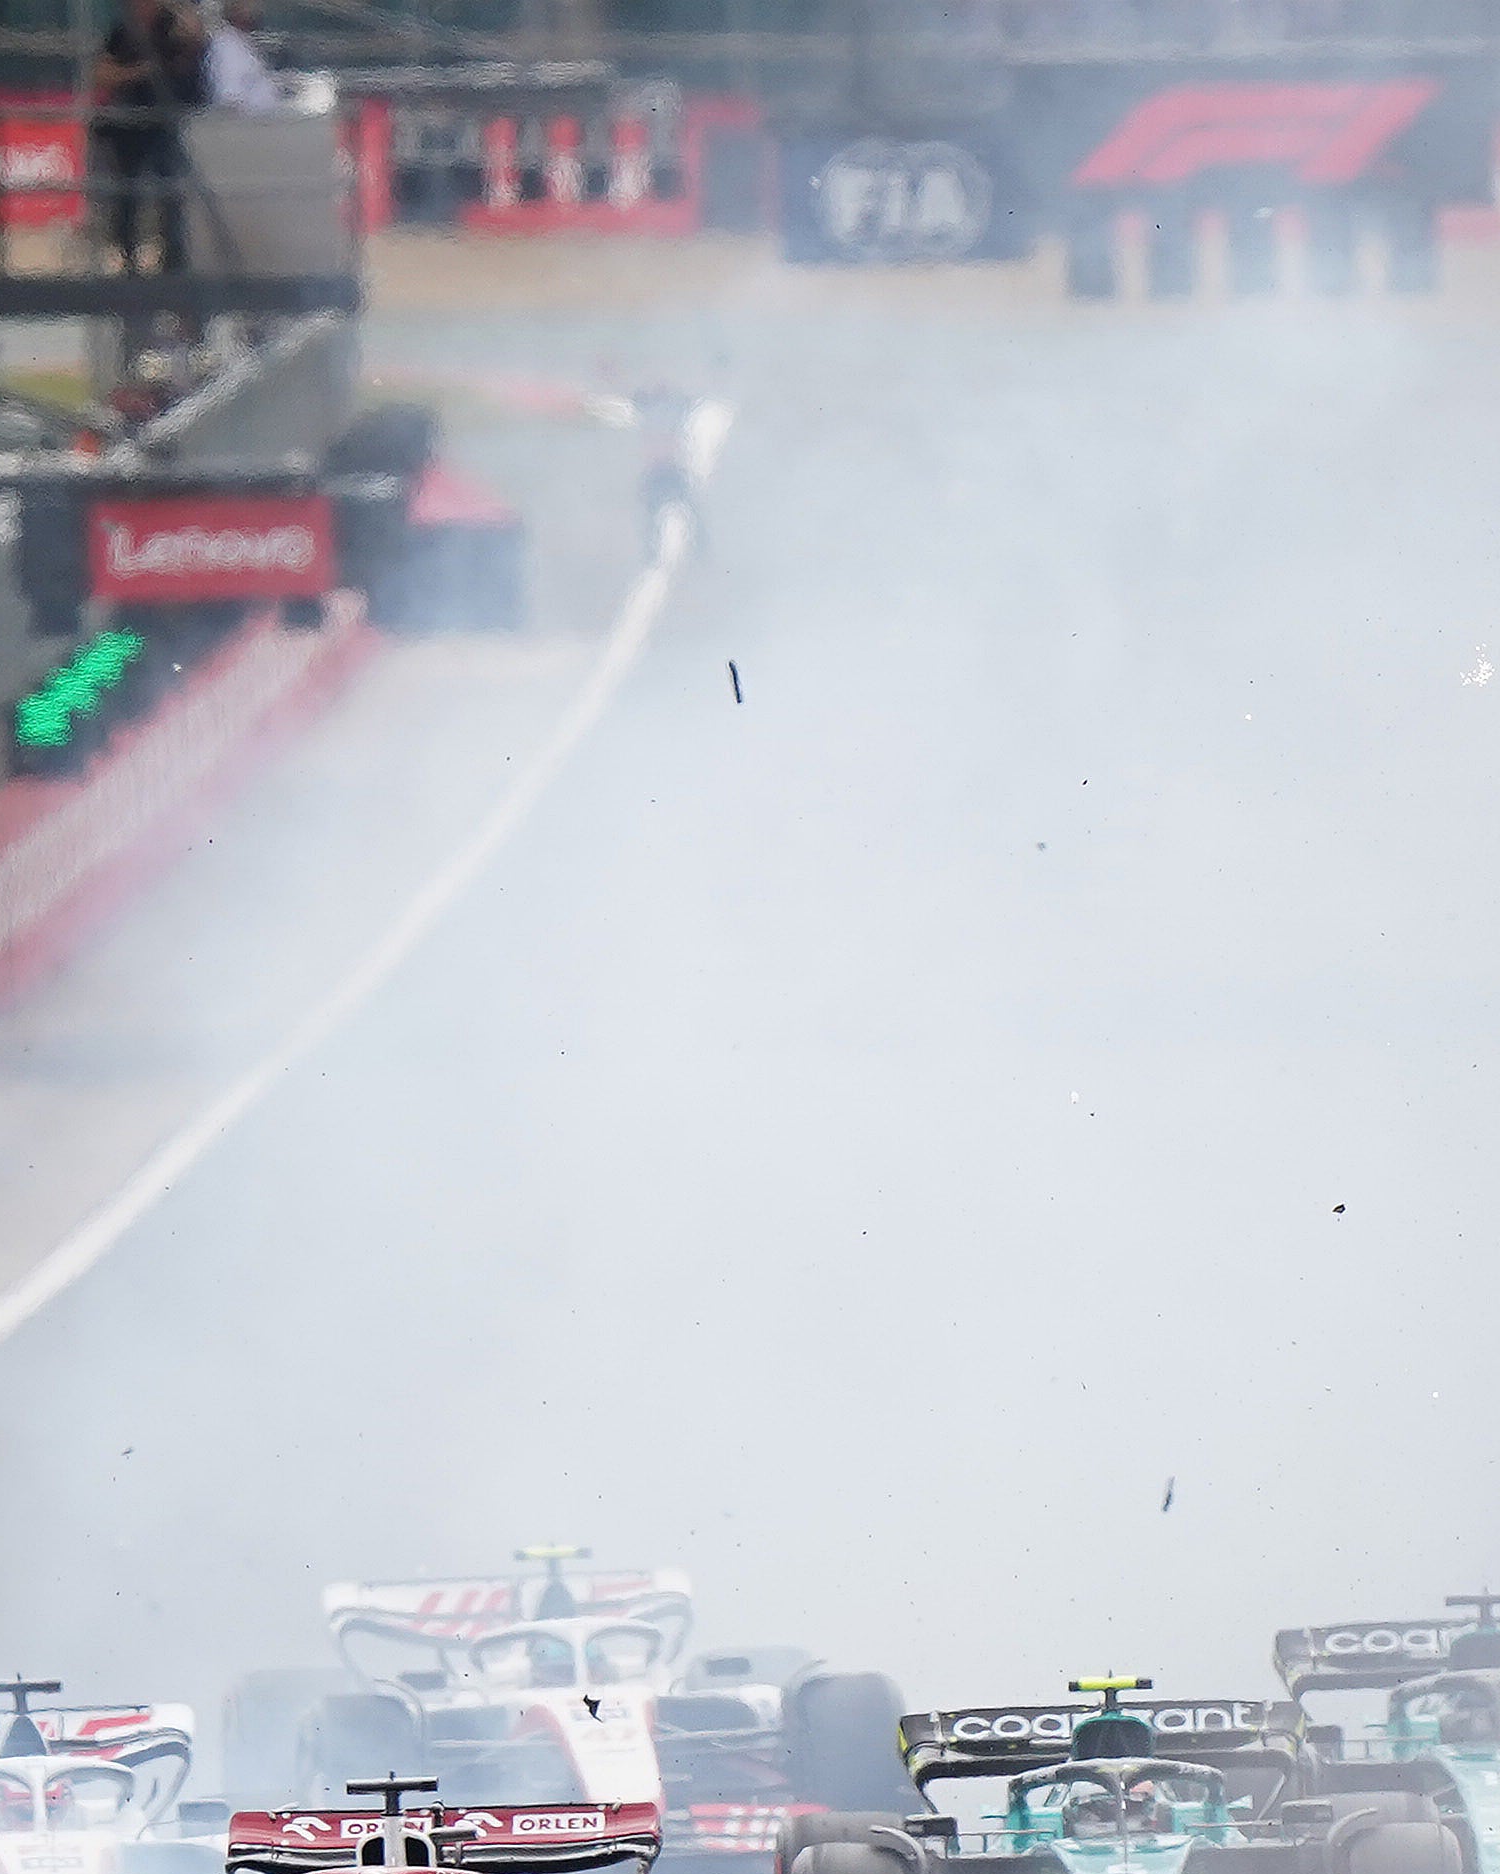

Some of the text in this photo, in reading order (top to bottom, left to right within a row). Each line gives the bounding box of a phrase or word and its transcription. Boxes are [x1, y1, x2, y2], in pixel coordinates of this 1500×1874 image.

[826, 165, 968, 230] FIA
[106, 521, 315, 578] Lenovo
[348, 1820, 425, 1834] ORN
[519, 1815, 598, 1831] ORLEN
